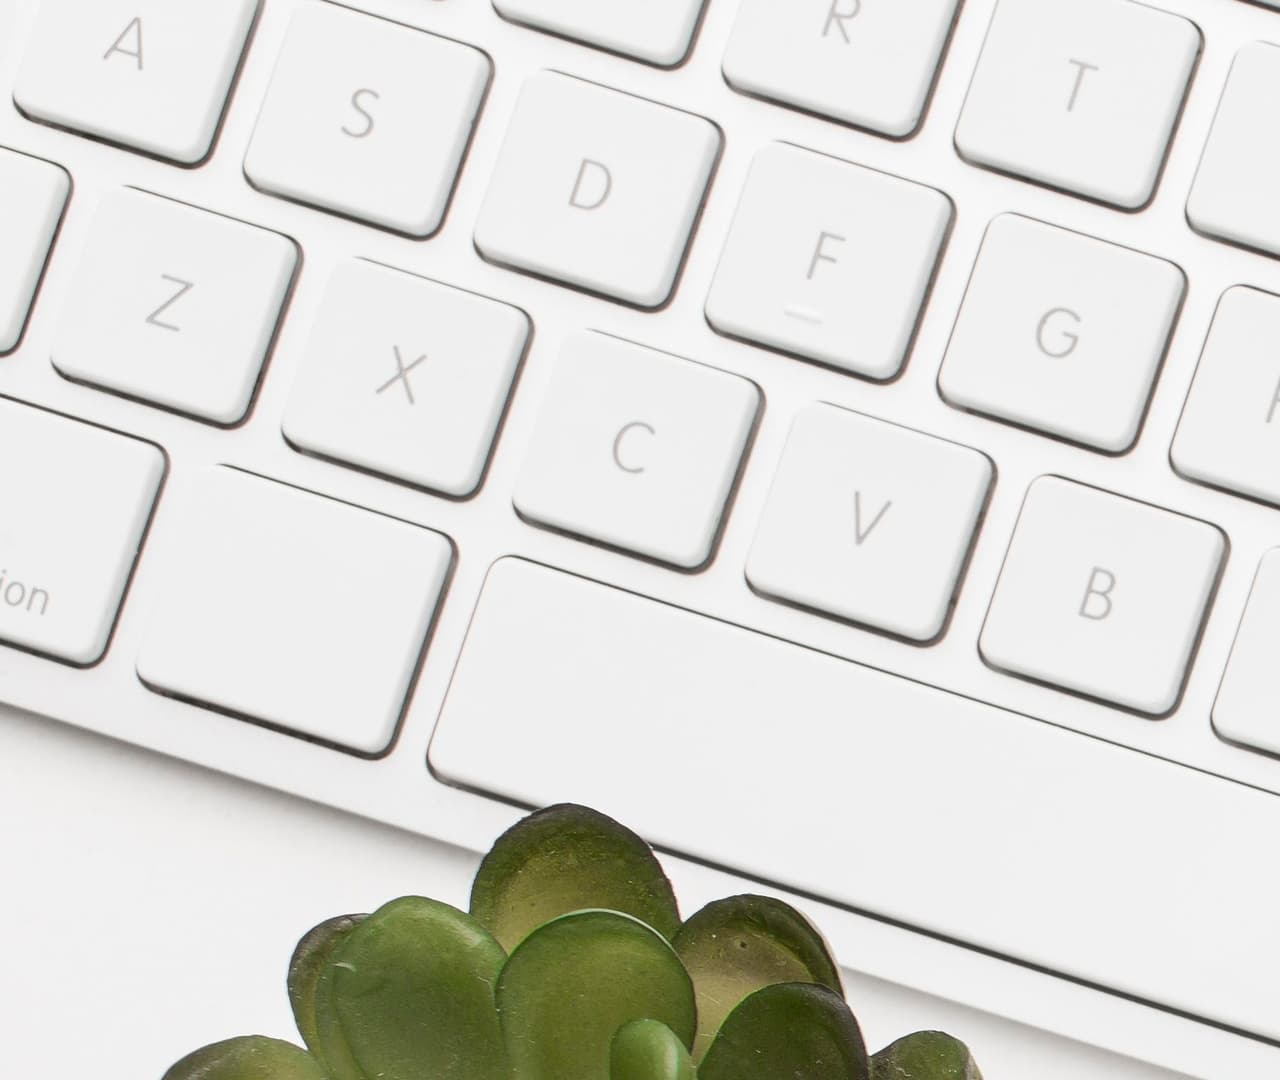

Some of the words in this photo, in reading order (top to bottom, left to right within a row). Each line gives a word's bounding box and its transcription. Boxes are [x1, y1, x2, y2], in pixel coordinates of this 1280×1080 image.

[102, 16, 144, 71] A
[821, 0, 861, 45] R
[340, 87, 380, 139] S
[1065, 58, 1099, 113] T
[567, 157, 613, 211] D
[806, 231, 846, 281] F
[145, 273, 195, 333] Z
[1035, 307, 1081, 359] G
[375, 344, 428, 406] X
[611, 420, 656, 475] C
[853, 490, 893, 546] V
[1078, 565, 1117, 621] B
